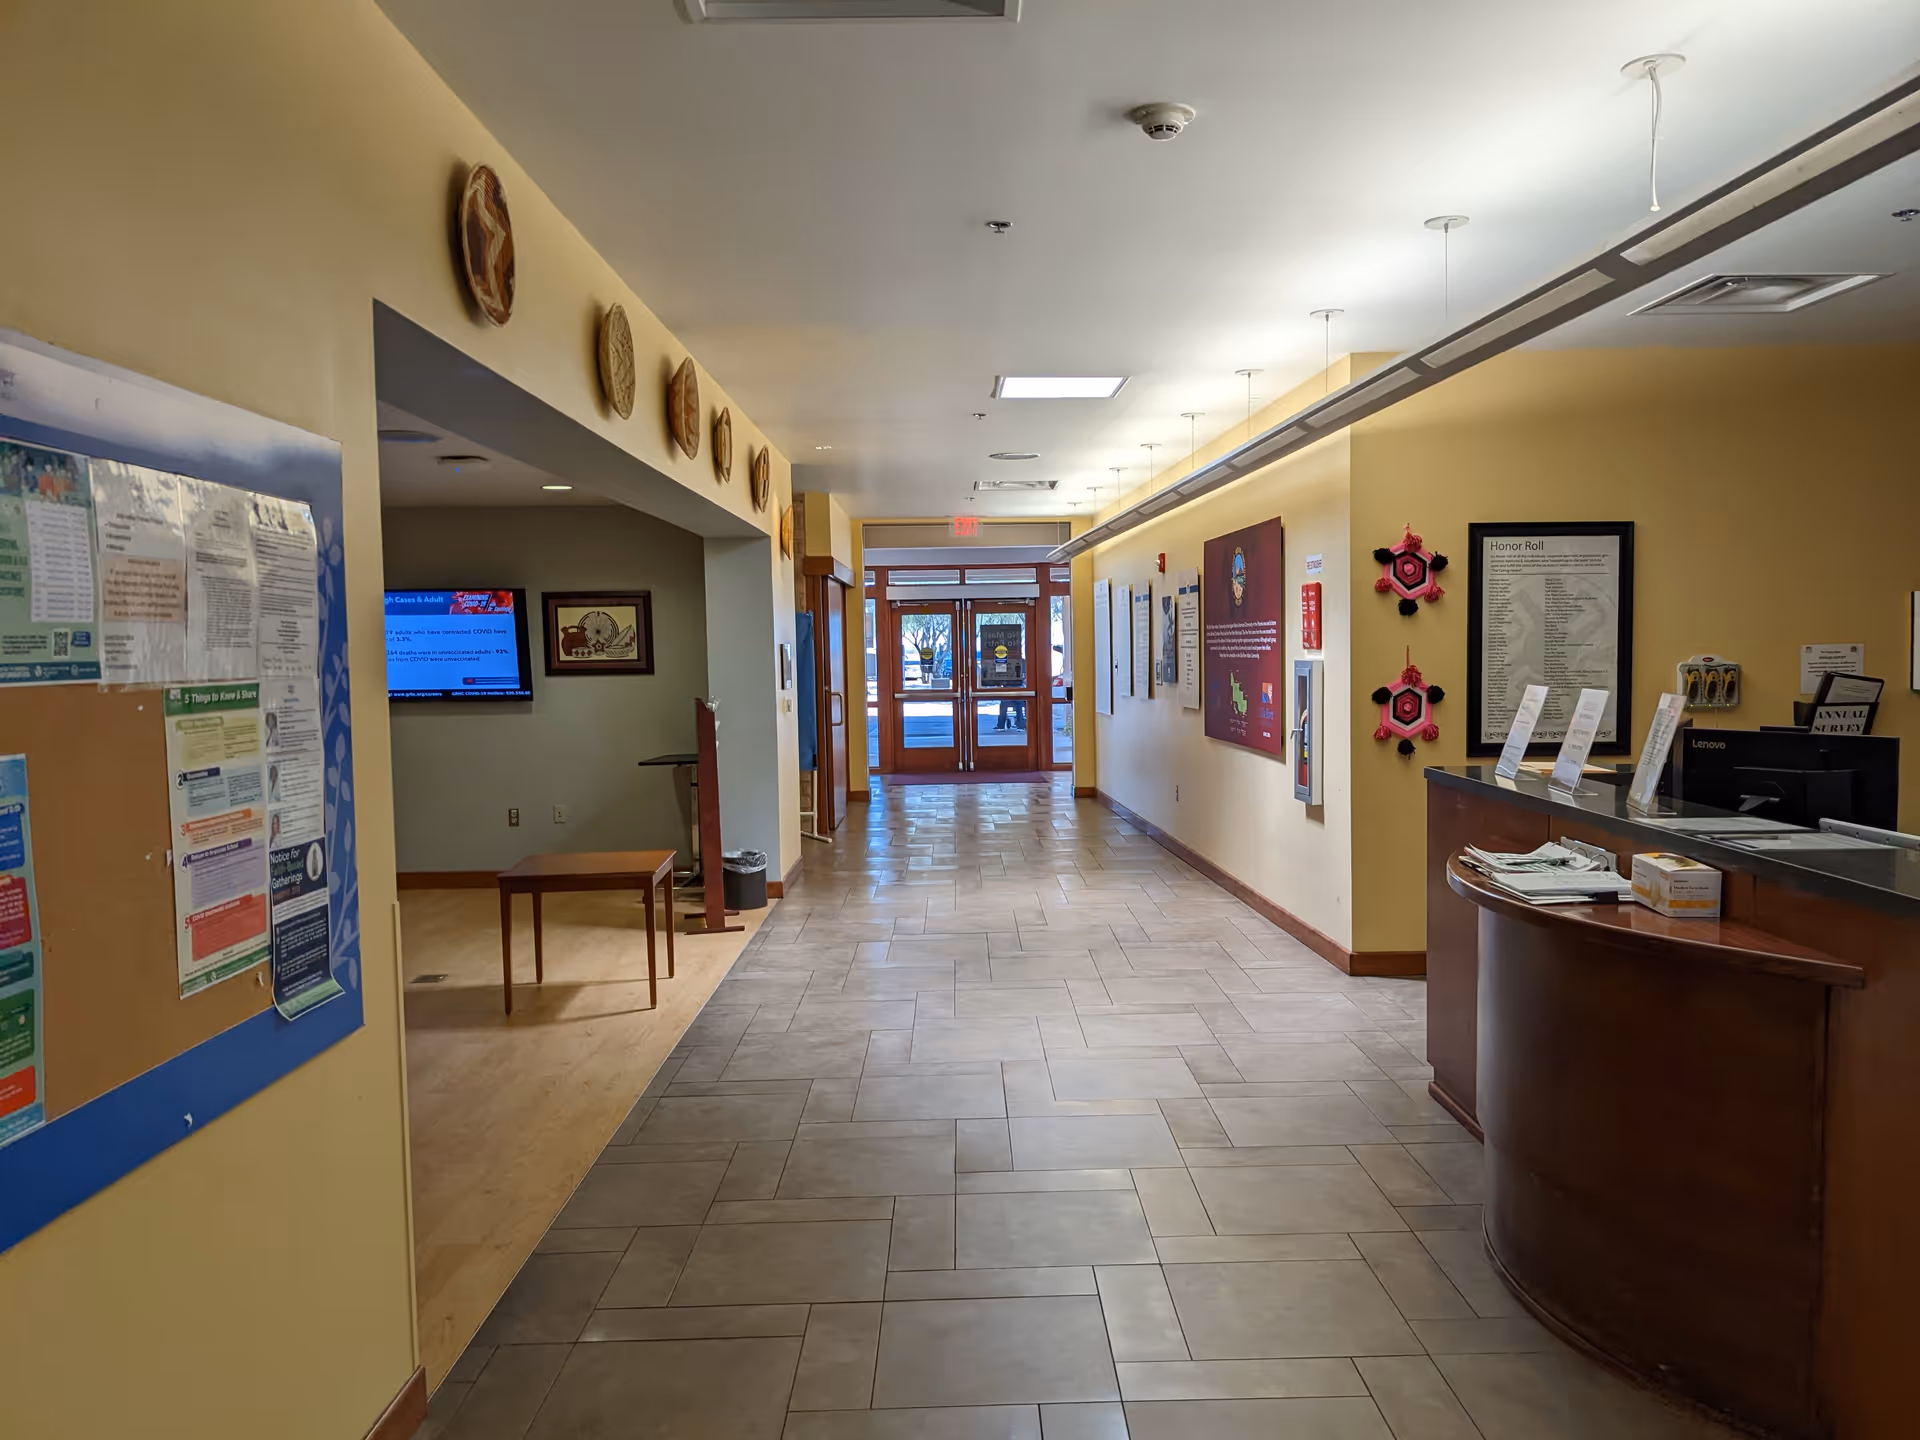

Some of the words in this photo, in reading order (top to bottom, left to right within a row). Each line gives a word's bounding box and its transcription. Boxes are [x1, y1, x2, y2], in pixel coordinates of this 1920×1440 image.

[955, 517, 977, 536] EXIT
[1490, 541, 1522, 551] Honor
[1525, 540, 1544, 551] Roll
[395, 596, 415, 604] Cases
[416, 596, 423, 604] &
[424, 596, 444, 604] Adult
[184, 694, 190, 704] 5
[191, 693, 211, 704] Things
[212, 693, 219, 702] to
[220, 691, 236, 700] Know
[241, 690, 257, 699] Share
[1815, 710, 1867, 719] ANNUAL
[1814, 723, 1863, 733] SURVEY
[1692, 738, 1726, 749] Lenovo
[178, 772, 184, 786] 2
[180, 824, 187, 836] 3
[270, 850, 290, 865] Notice
[290, 847, 301, 859] for
[182, 857, 189, 869] 4
[271, 871, 303, 889] Gatherings
[184, 917, 190, 930] 5
